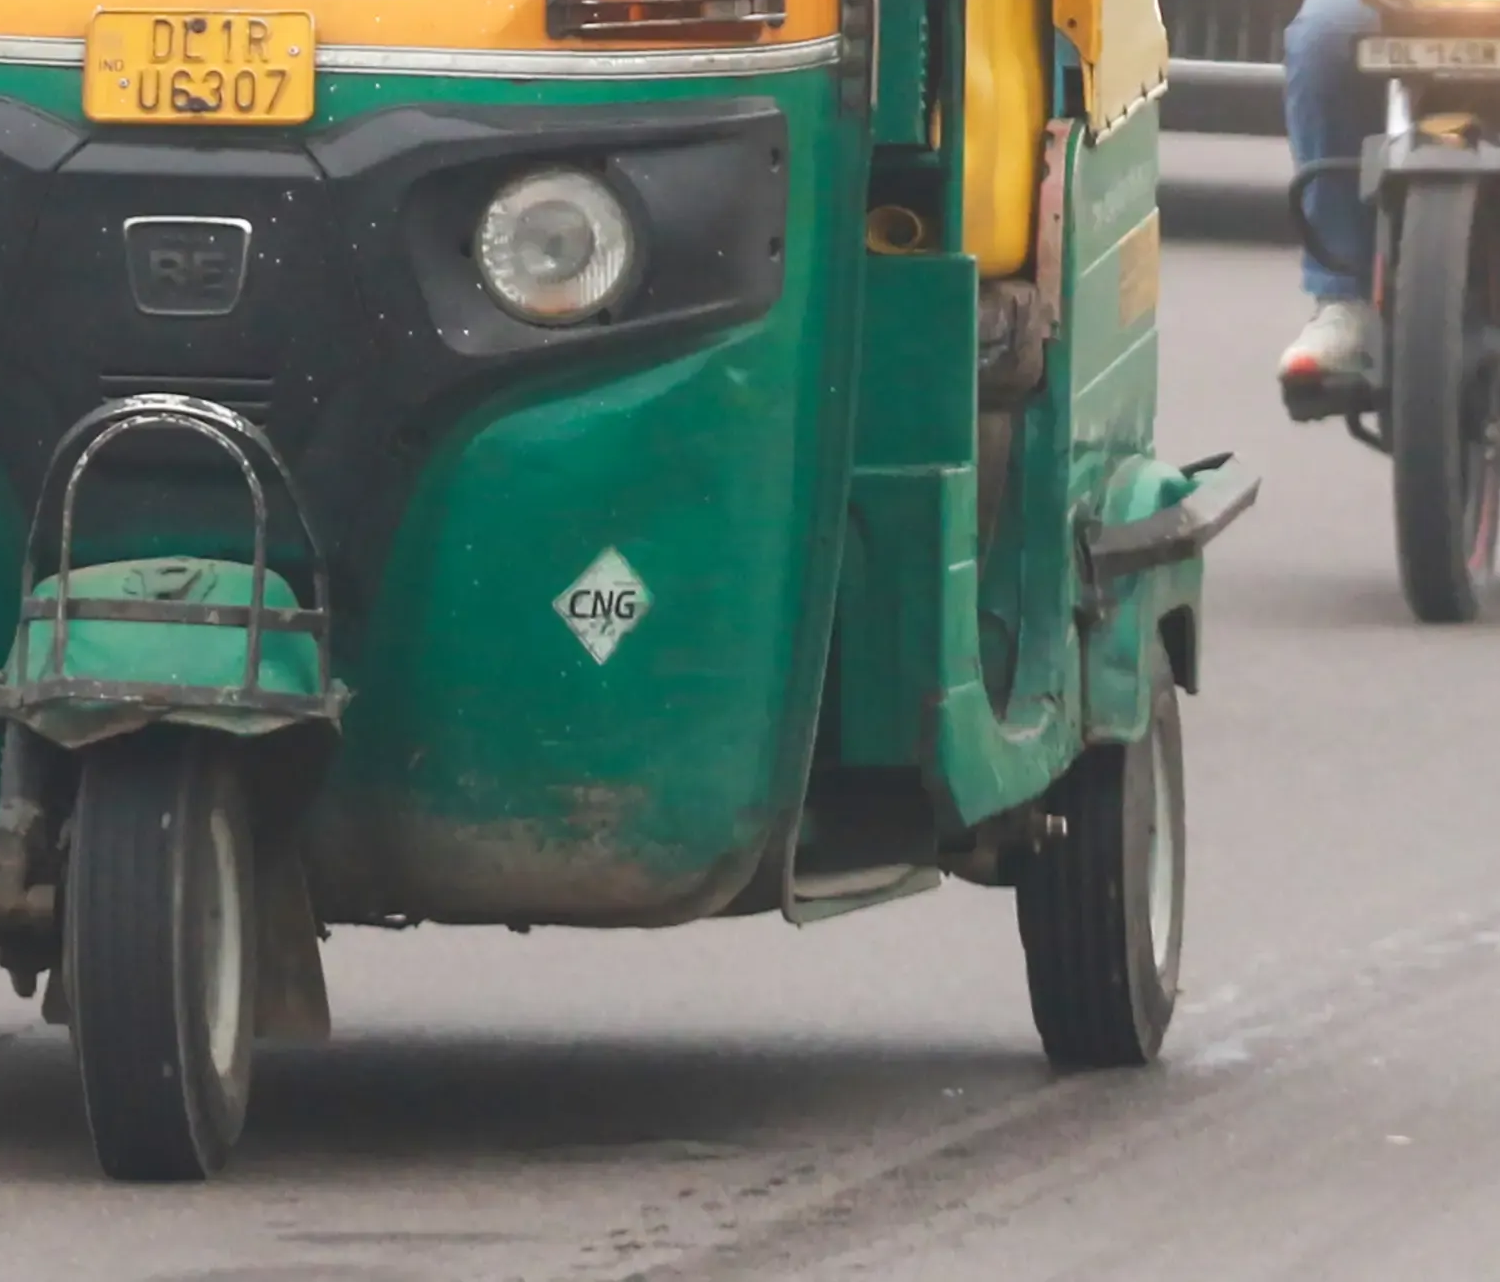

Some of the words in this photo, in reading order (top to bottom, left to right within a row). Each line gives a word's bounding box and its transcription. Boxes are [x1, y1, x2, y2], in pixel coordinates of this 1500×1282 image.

[99, 59, 125, 73] IND
[137, 68, 289, 116] U6307
[150, 250, 226, 290] RE
[569, 590, 637, 619] CNG
